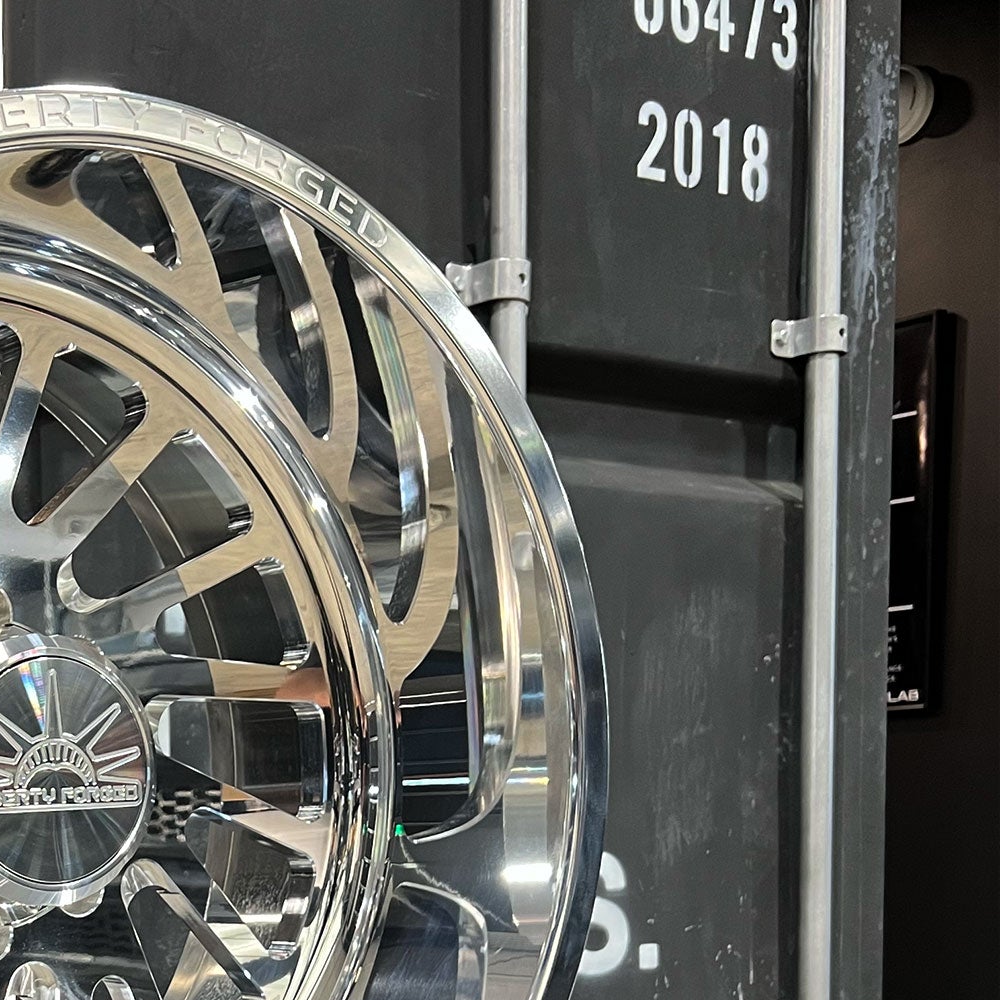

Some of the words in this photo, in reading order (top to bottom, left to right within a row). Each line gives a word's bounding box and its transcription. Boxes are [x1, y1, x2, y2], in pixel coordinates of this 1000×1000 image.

[636, 100, 769, 202] 2018
[179, 116, 390, 248] FORGED
[887, 689, 919, 703] LAB
[61, 784, 139, 804] FORGED
